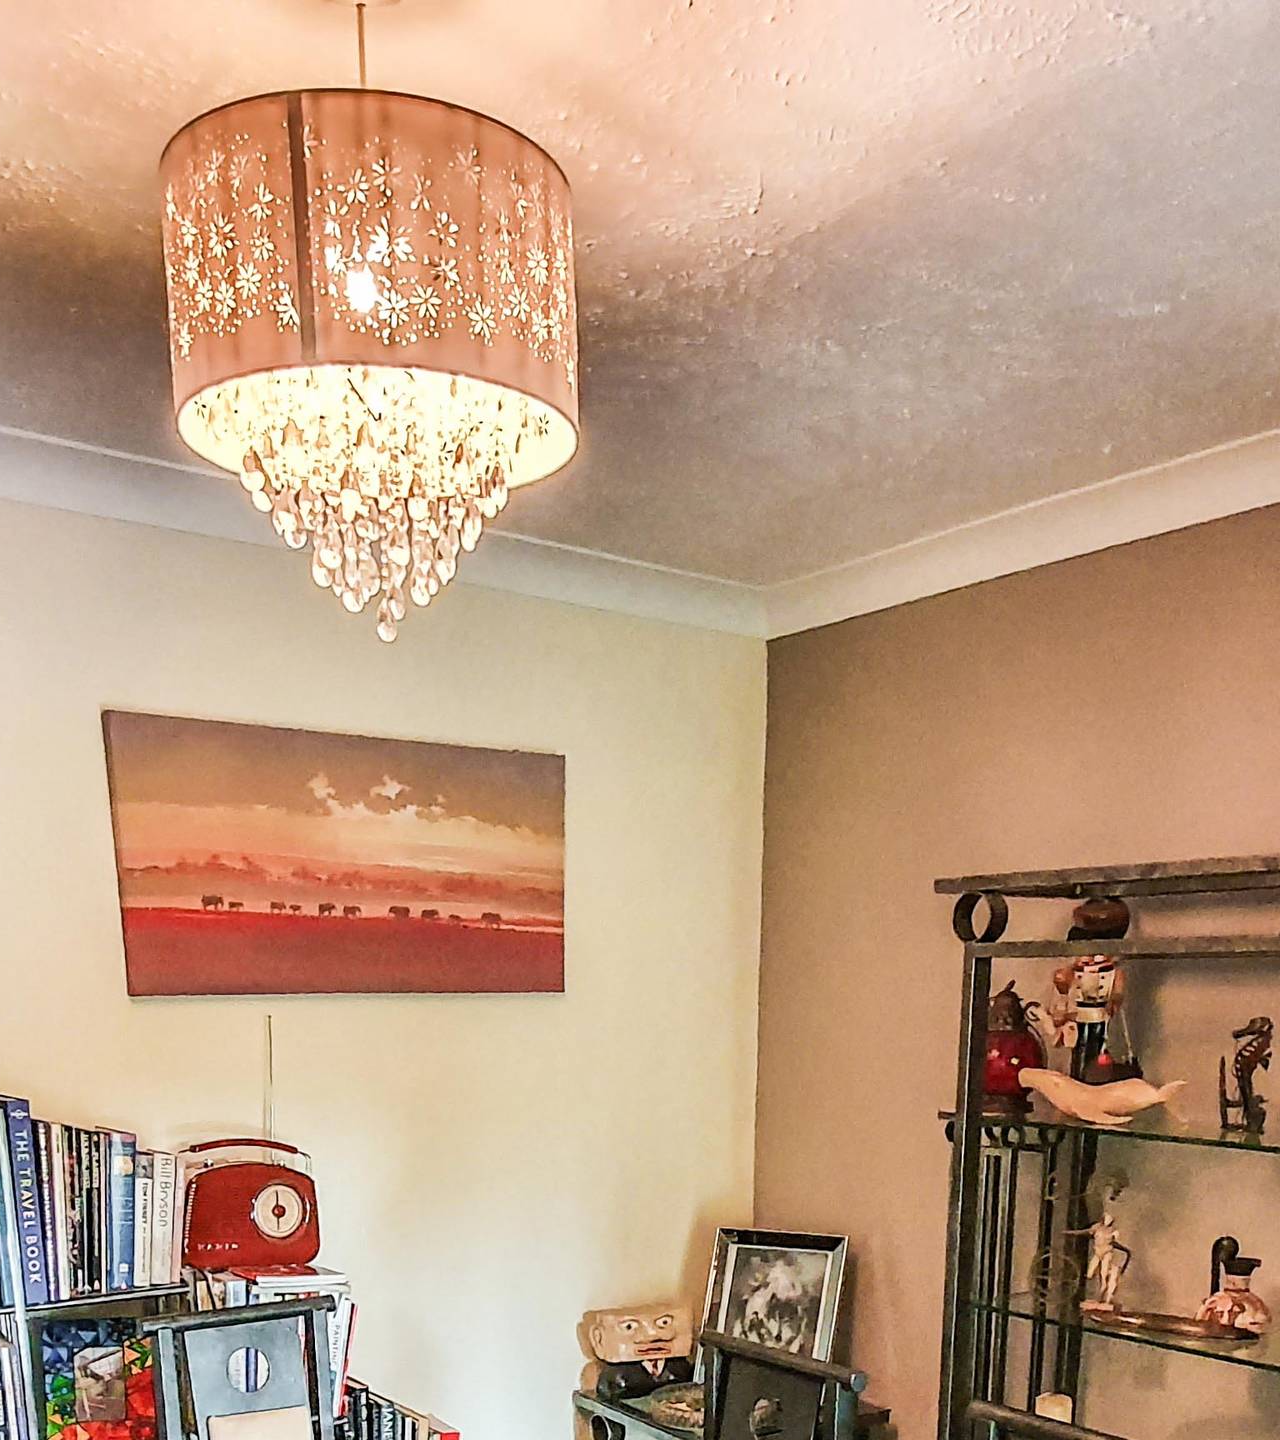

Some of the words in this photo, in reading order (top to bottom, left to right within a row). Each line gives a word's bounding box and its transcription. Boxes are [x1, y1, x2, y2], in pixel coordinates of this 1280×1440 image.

[13, 1129, 29, 1162] THE
[161, 1158, 172, 1178] Bill
[17, 1168, 37, 1229] TRAVEL
[158, 1181, 172, 1227] Bryson
[25, 1236, 42, 1283] BOOK
